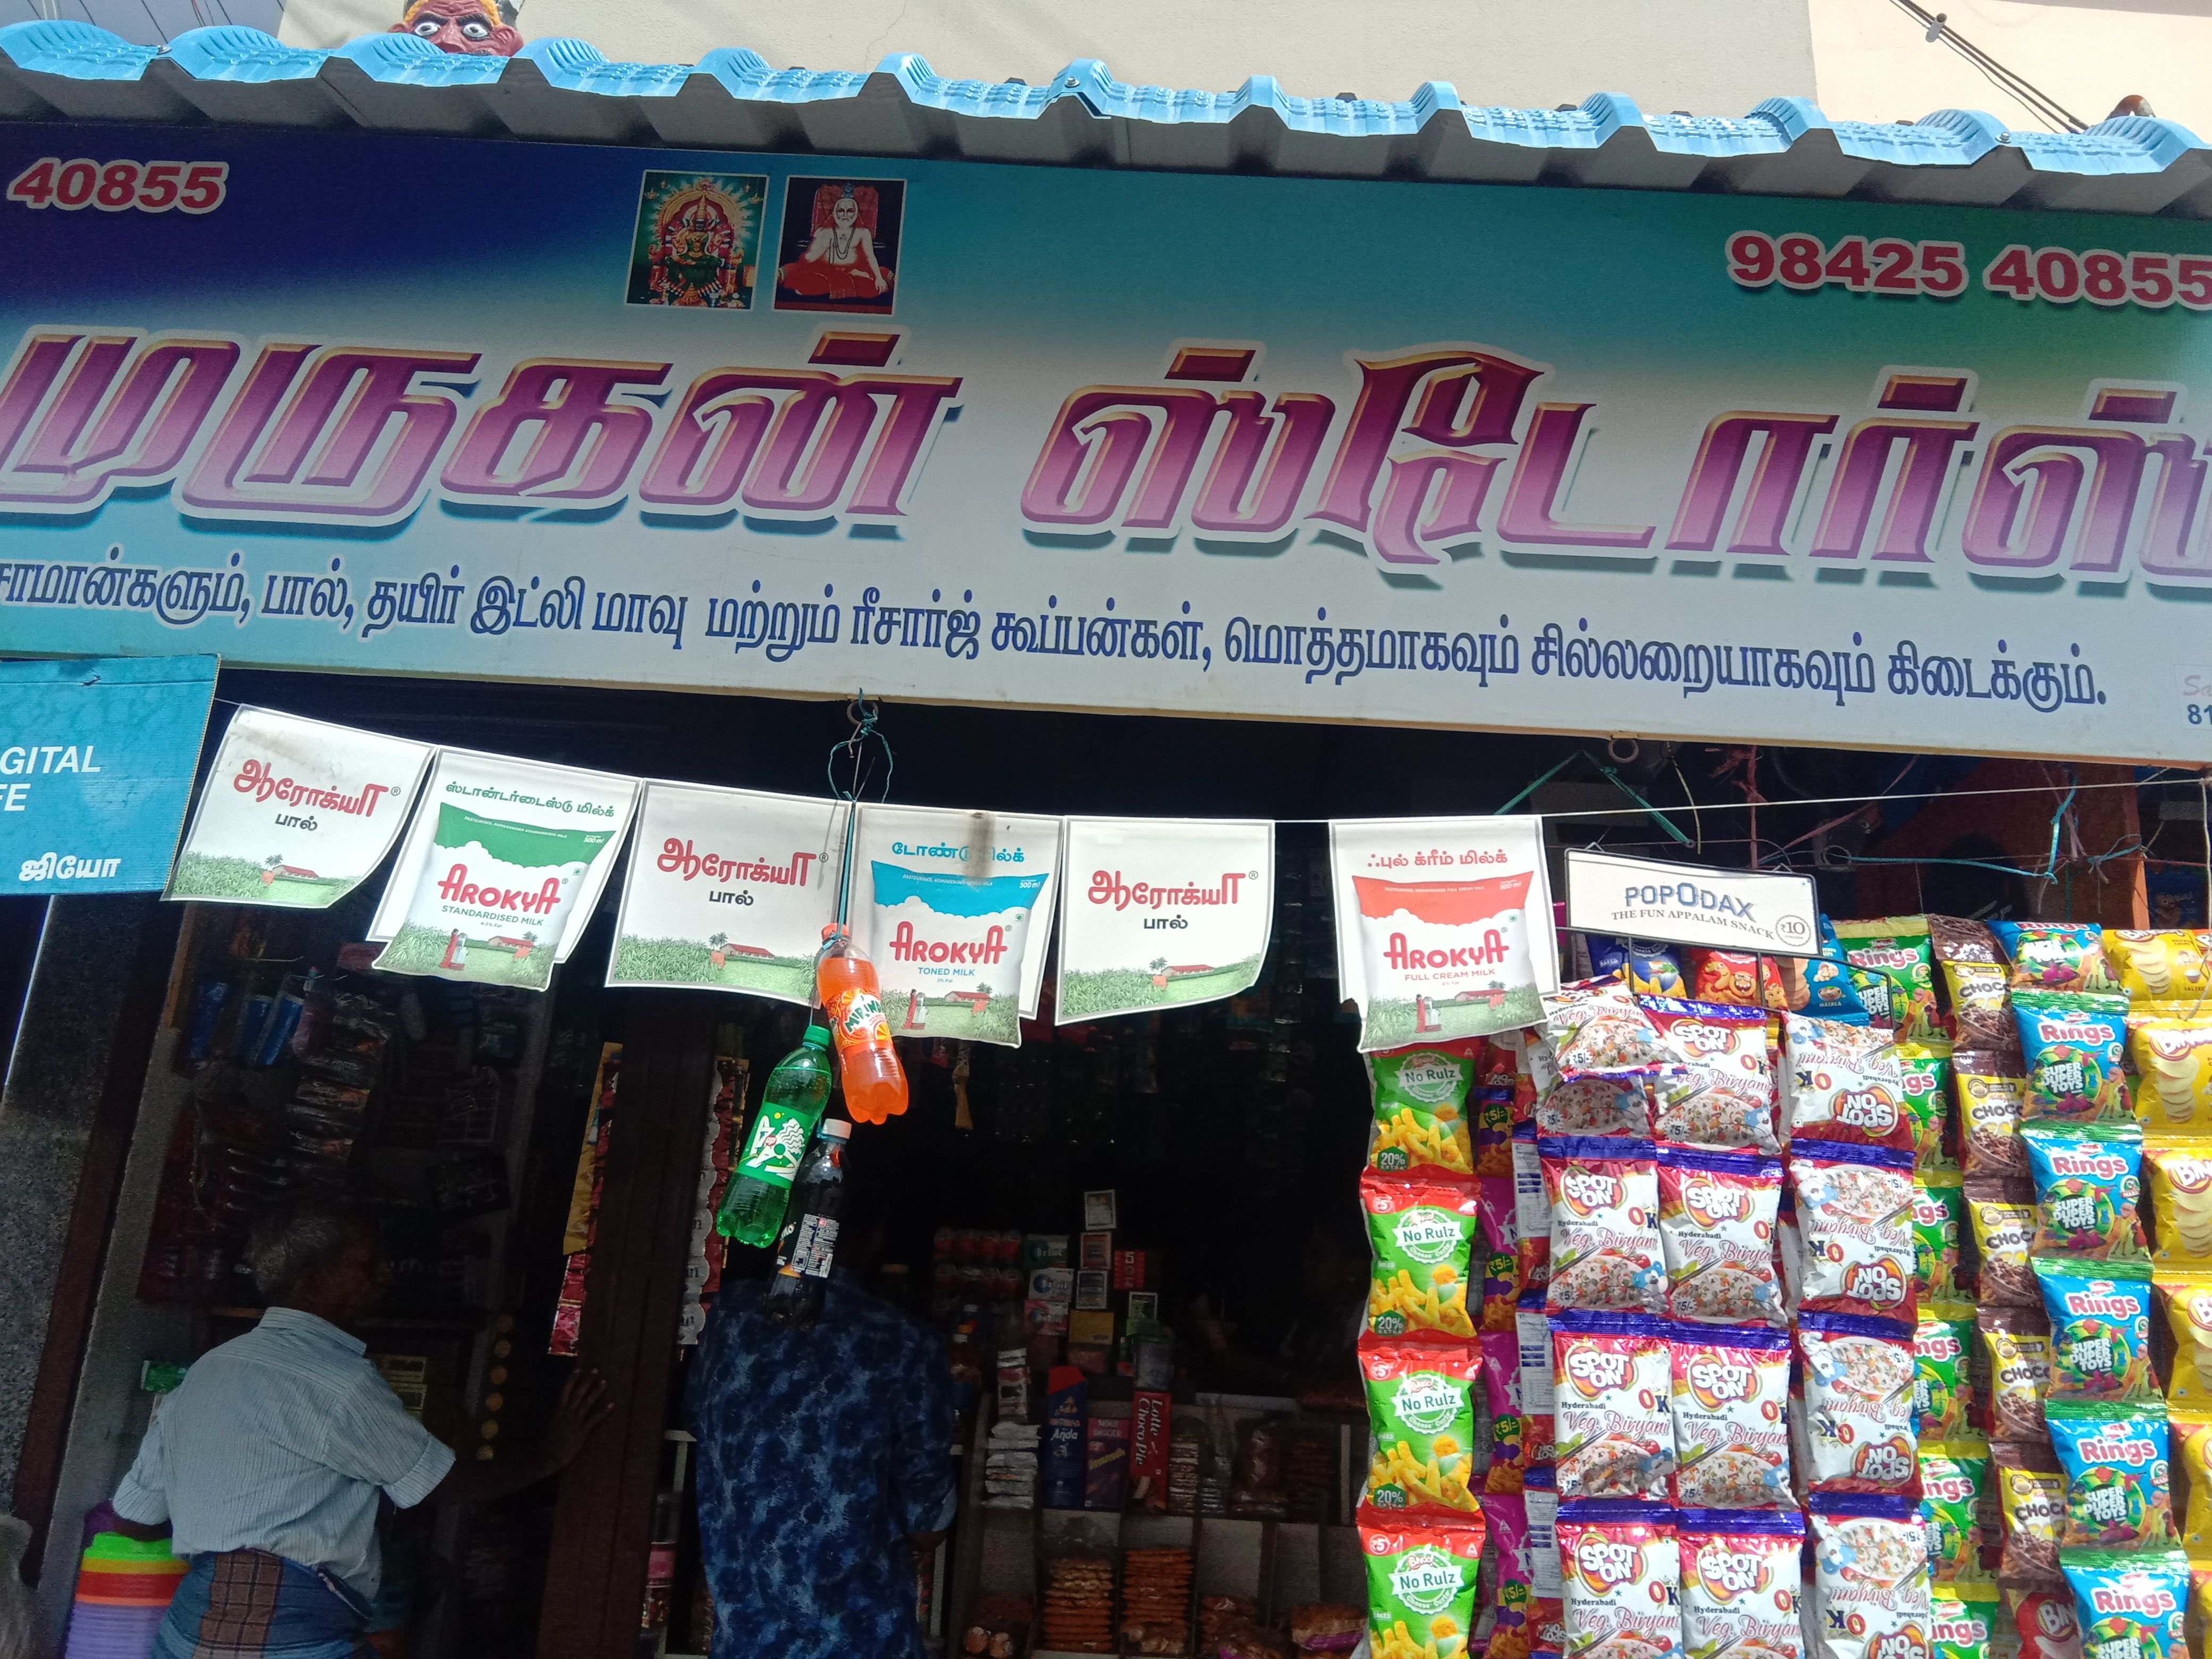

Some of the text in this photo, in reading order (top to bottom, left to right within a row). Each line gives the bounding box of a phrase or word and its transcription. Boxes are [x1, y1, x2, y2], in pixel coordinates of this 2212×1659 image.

[13, 161, 224, 209] 40855
[1731, 235, 2212, 306] 98425 40855
[0, 332, 963, 518] முருகன்
[0, 548, 2107, 713] ாமான்களும், பால், தயிர் இட்லி மாவு மற்றும் ரீசார்ஜ் கூப்பன்கள், மொத்தமாகவும் சில்லறையாகவும் கிடைக்கும்.
[233, 759, 389, 817] ஆரோக்யா
[576, 801, 615, 817] மில்க்
[275, 814, 318, 831] பால்
[19, 852, 121, 881] ஜியோ
[657, 837, 817, 886] ஆரோக்யா
[1460, 849, 1508, 865] மில்க்
[709, 890, 754, 906] பால்
[1088, 870, 1246, 911] ஆரோக்யா
[1624, 882, 1756, 923] POPODAX
[442, 905, 543, 927] STANDARDISED MILK
[1144, 914, 1188, 929] பால்
[1611, 909, 1775, 941] THE FUN APPALAM SNACK
[1848, 949, 1918, 968] Rings
[918, 967, 975, 976] TONED MILK
[1432, 971, 1468, 980] CREAM
[1674, 1024, 1730, 1044] SPOT
[2040, 1025, 2113, 1043] Rings
[1693, 1038, 1724, 1051] ON
[1405, 1068, 1456, 1083] No Rulz
[2043, 1062, 2082, 1076] SUPER
[2050, 1080, 2084, 1093] TOYS
[1847, 1092, 1876, 1110] ON
[1836, 1103, 1893, 1127] SPOT
[1381, 1152, 1405, 1165] 20%
[2052, 1155, 2126, 1178] Rings
[1564, 1174, 1618, 1197] SPOT
[1581, 1189, 1612, 1207] ON
[2055, 1196, 2094, 1211] SUPER
[2054, 1208, 2095, 1223] DUPER
[2062, 1216, 2096, 1228] TOYS
[1403, 1226, 1455, 1243] No Rulz
[1678, 1231, 1721, 1239] Hyderabadi
[1858, 1266, 1887, 1284] ON
[1847, 1276, 1901, 1301] SPOT
[2067, 1294, 2139, 1318] Rings
[1378, 1316, 1403, 1329] 20%
[2072, 1338, 2112, 1354] SUPER
[1569, 1351, 1629, 1377] SPOT
[2079, 1358, 2112, 1371] TOYS
[1589, 1369, 1622, 1388] ON
[1691, 1364, 1752, 1388] SPOT
[1712, 1382, 1745, 1400] ON
[1401, 1393, 1456, 1412] No Rulz
[1561, 1402, 1606, 1410] Hyderabadi
[1563, 1410, 1670, 1438] Veg. Biryani
[1682, 1412, 1728, 1421] Hyderabadi
[1685, 1421, 1721, 1448] Veg.
[1868, 1446, 1897, 1463] ON
[2080, 1438, 2156, 1464] Rings
[1856, 1457, 1909, 1480] SPOT
[1376, 1490, 1403, 1503] 20%
[2085, 1486, 2125, 1503] SUPER
[2084, 1497, 2126, 1514] DUPER
[2094, 1505, 2126, 1521] TOYS
[1580, 1542, 1637, 1572] SPOT
[1700, 1552, 1763, 1577] SPOT
[1400, 1570, 1456, 1590] No Rulz
[1599, 1562, 1633, 1583] ON
[1721, 1571, 1755, 1591] ON
[1571, 1598, 1616, 1606] Hyderabadi
[1694, 1605, 1740, 1614] Hyderabadi
[2094, 1589, 2173, 1616] Rings
[1572, 1606, 1610, 1634] Veg.
[1695, 1615, 1733, 1642] Veg.
[1881, 1636, 1910, 1655] ON
